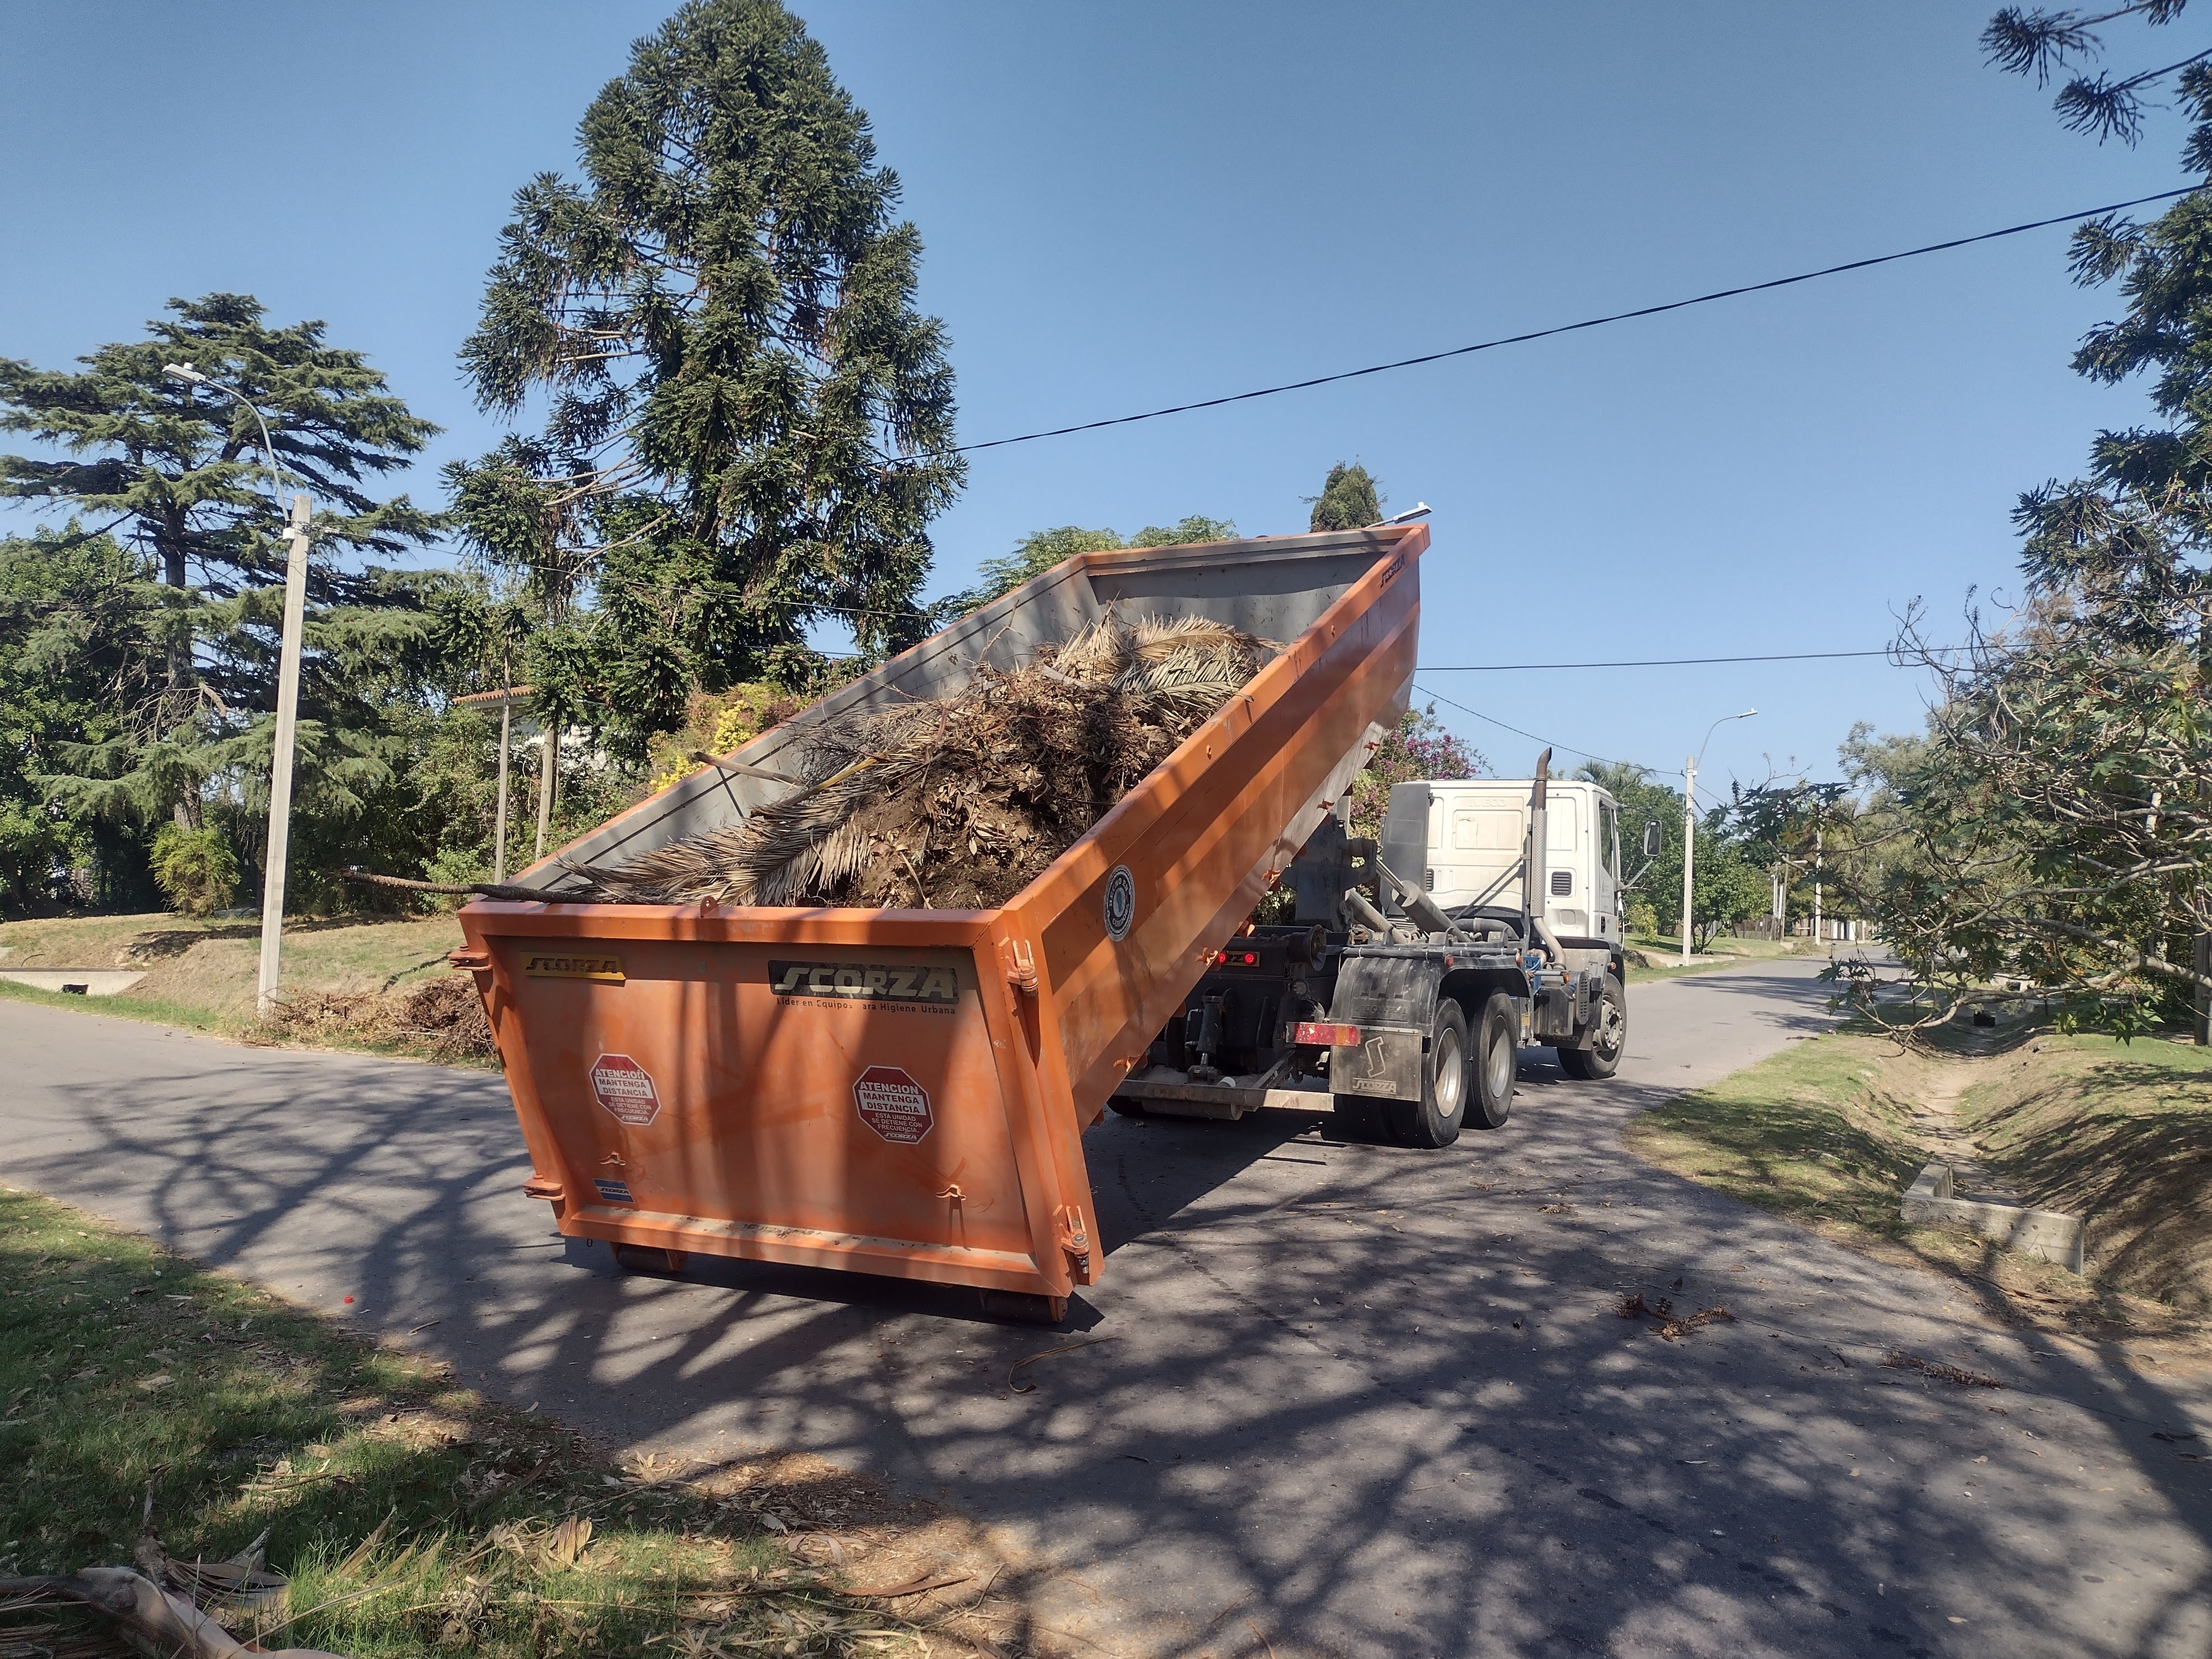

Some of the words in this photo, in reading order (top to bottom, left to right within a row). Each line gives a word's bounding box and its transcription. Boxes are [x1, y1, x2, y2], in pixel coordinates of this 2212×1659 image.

[1109, 877, 1122, 907] HECHO
[525, 958, 618, 973] SCORZA
[775, 967, 954, 999] SCORZA
[880, 1003, 916, 1013] Higiene
[595, 1068, 645, 1079] ATENCION
[598, 1078, 647, 1088] MANTENGA
[860, 1082, 919, 1094] ATENCION
[1353, 1080, 1396, 1092] SCORZA
[602, 1087, 648, 1097] DISTANCIA
[863, 1092, 920, 1104] MANTENGA
[867, 1102, 920, 1114] DISTANCIA
[878, 1124, 920, 1133] FRECUENCIA.
